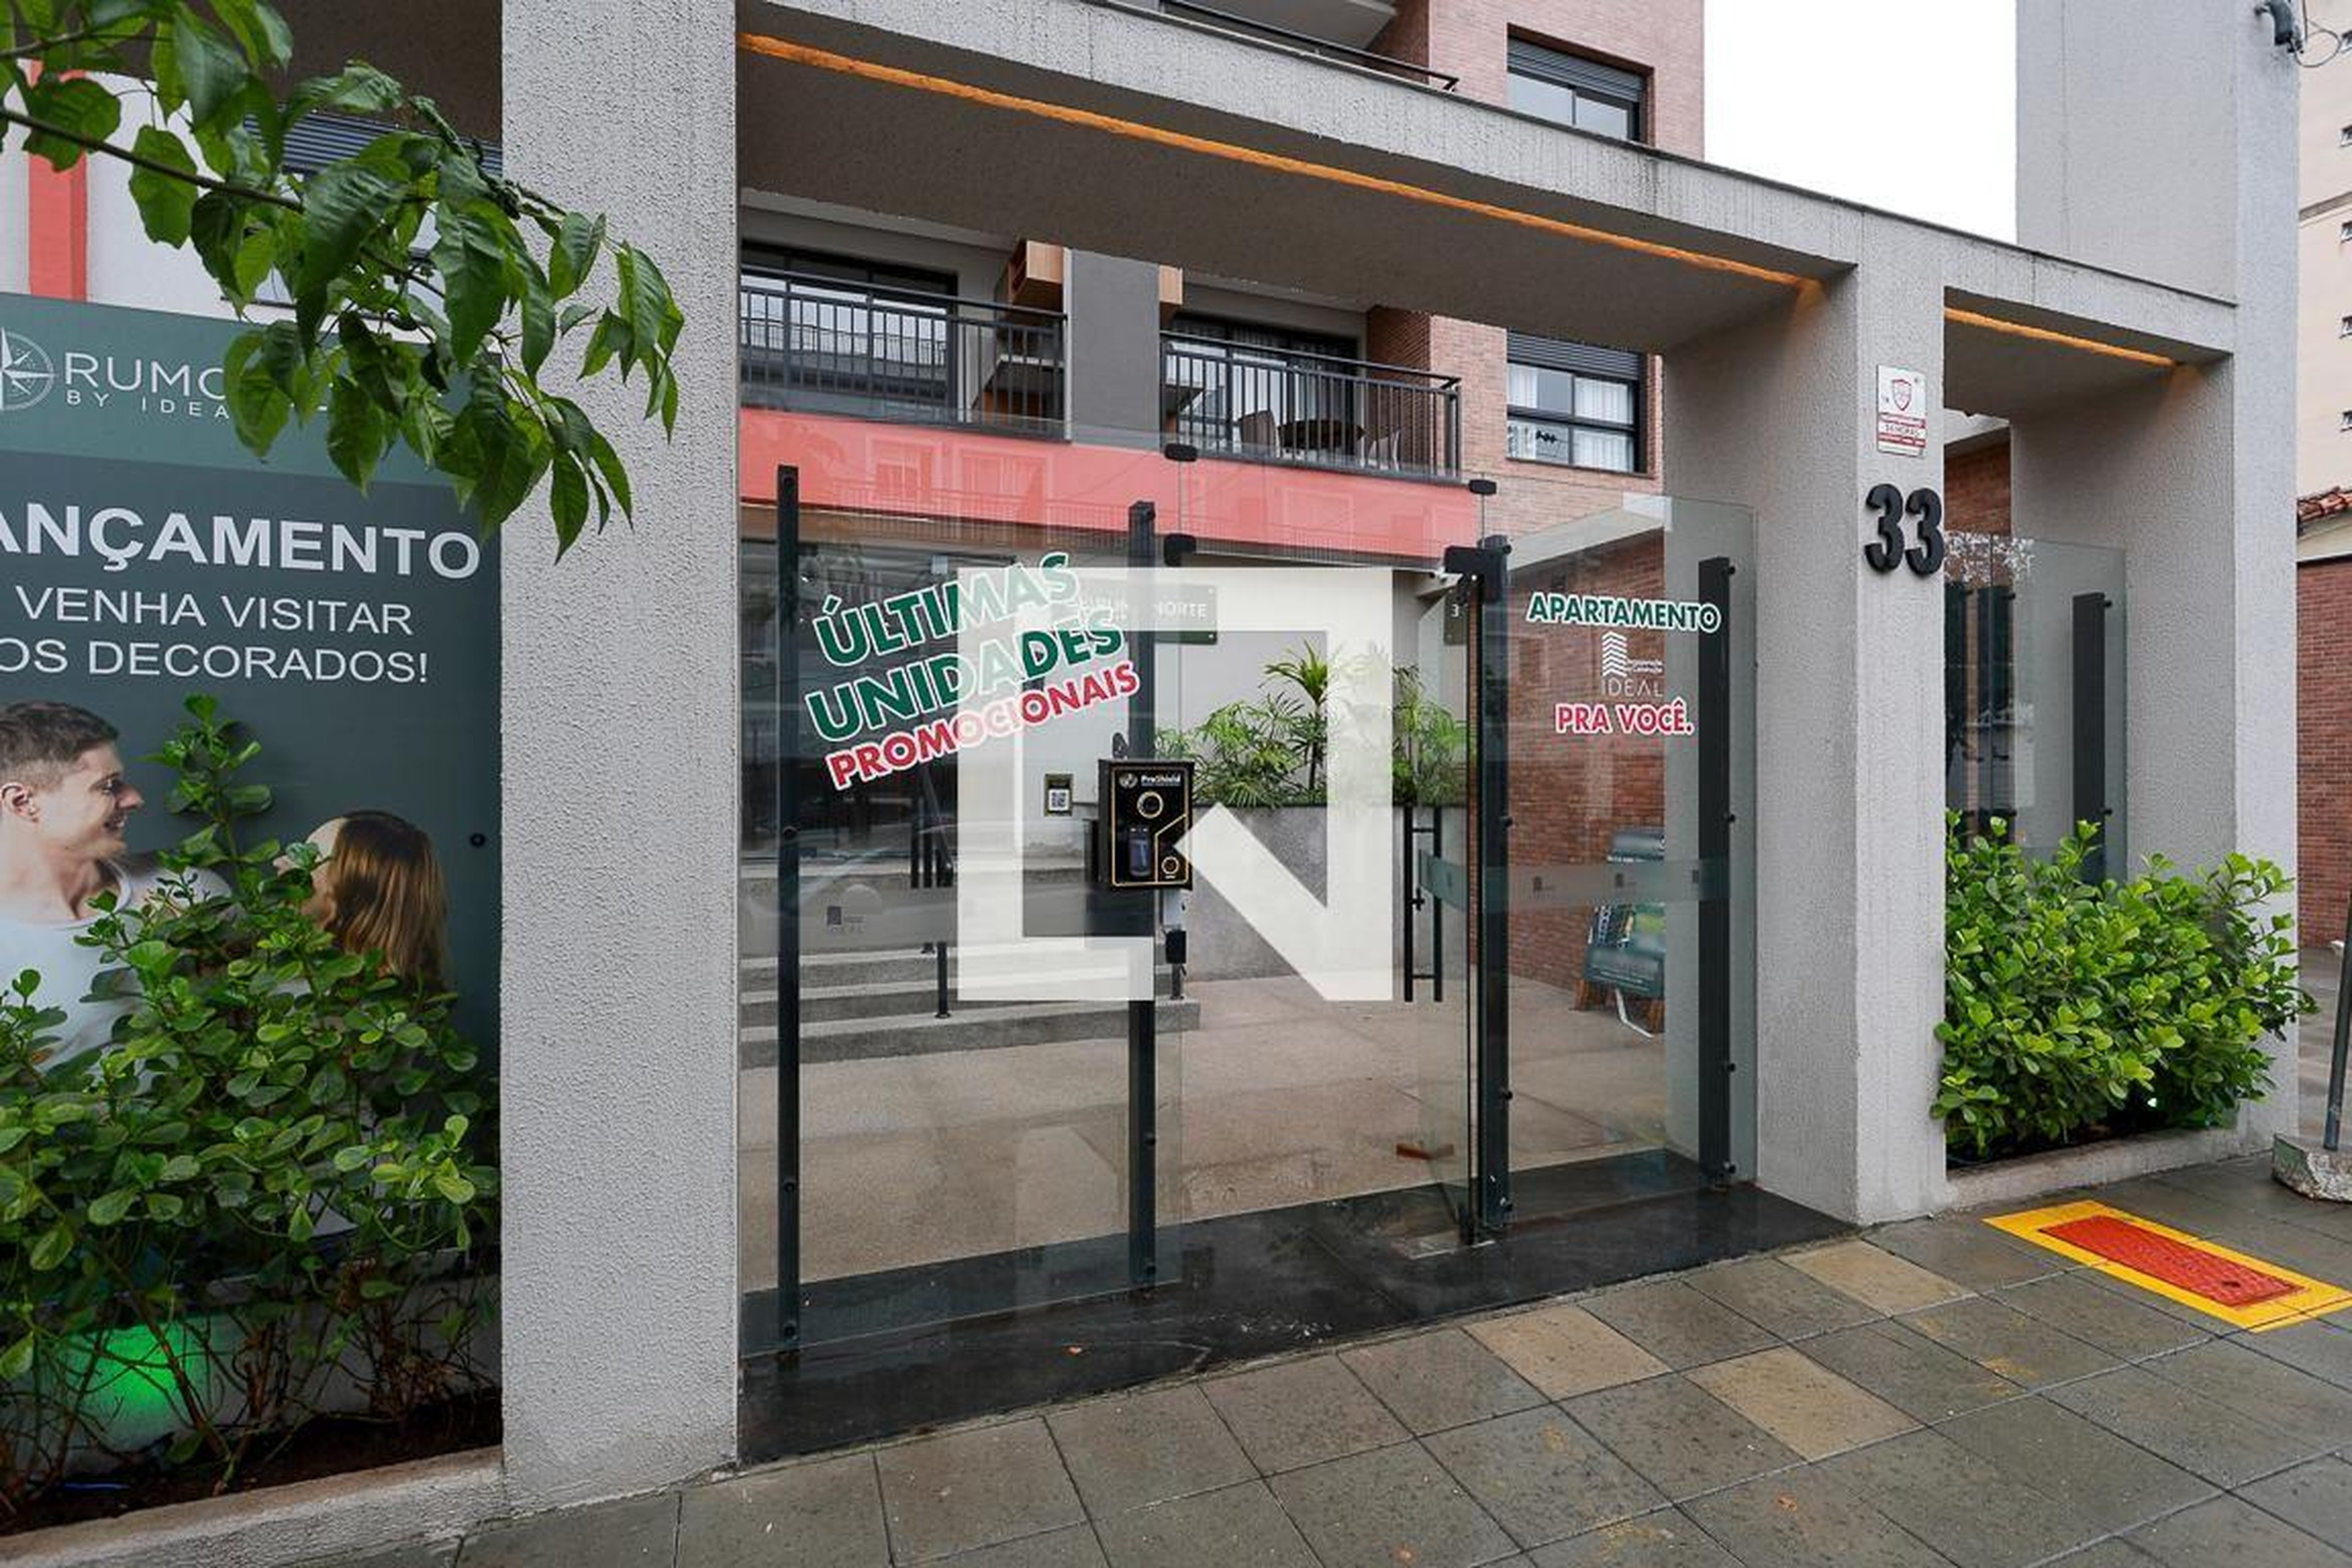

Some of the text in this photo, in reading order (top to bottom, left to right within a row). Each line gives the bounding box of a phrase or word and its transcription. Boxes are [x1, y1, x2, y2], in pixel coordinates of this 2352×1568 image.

[67, 391, 230, 420] BY IDEA
[1864, 483, 1945, 576] 33
[15, 586, 413, 635] VENHA VISITAR
[812, 552, 1081, 668] ÚLTIMAS
[1526, 591, 1722, 633] APARTAMENTO
[88, 641, 428, 683] DECORADOS!
[805, 605, 1125, 742] UNIDADES
[1602, 678, 1664, 697] IDEAL
[826, 660, 1140, 791] PROMOCIONAIS
[1555, 696, 1694, 736] PRA VOCÊ.
